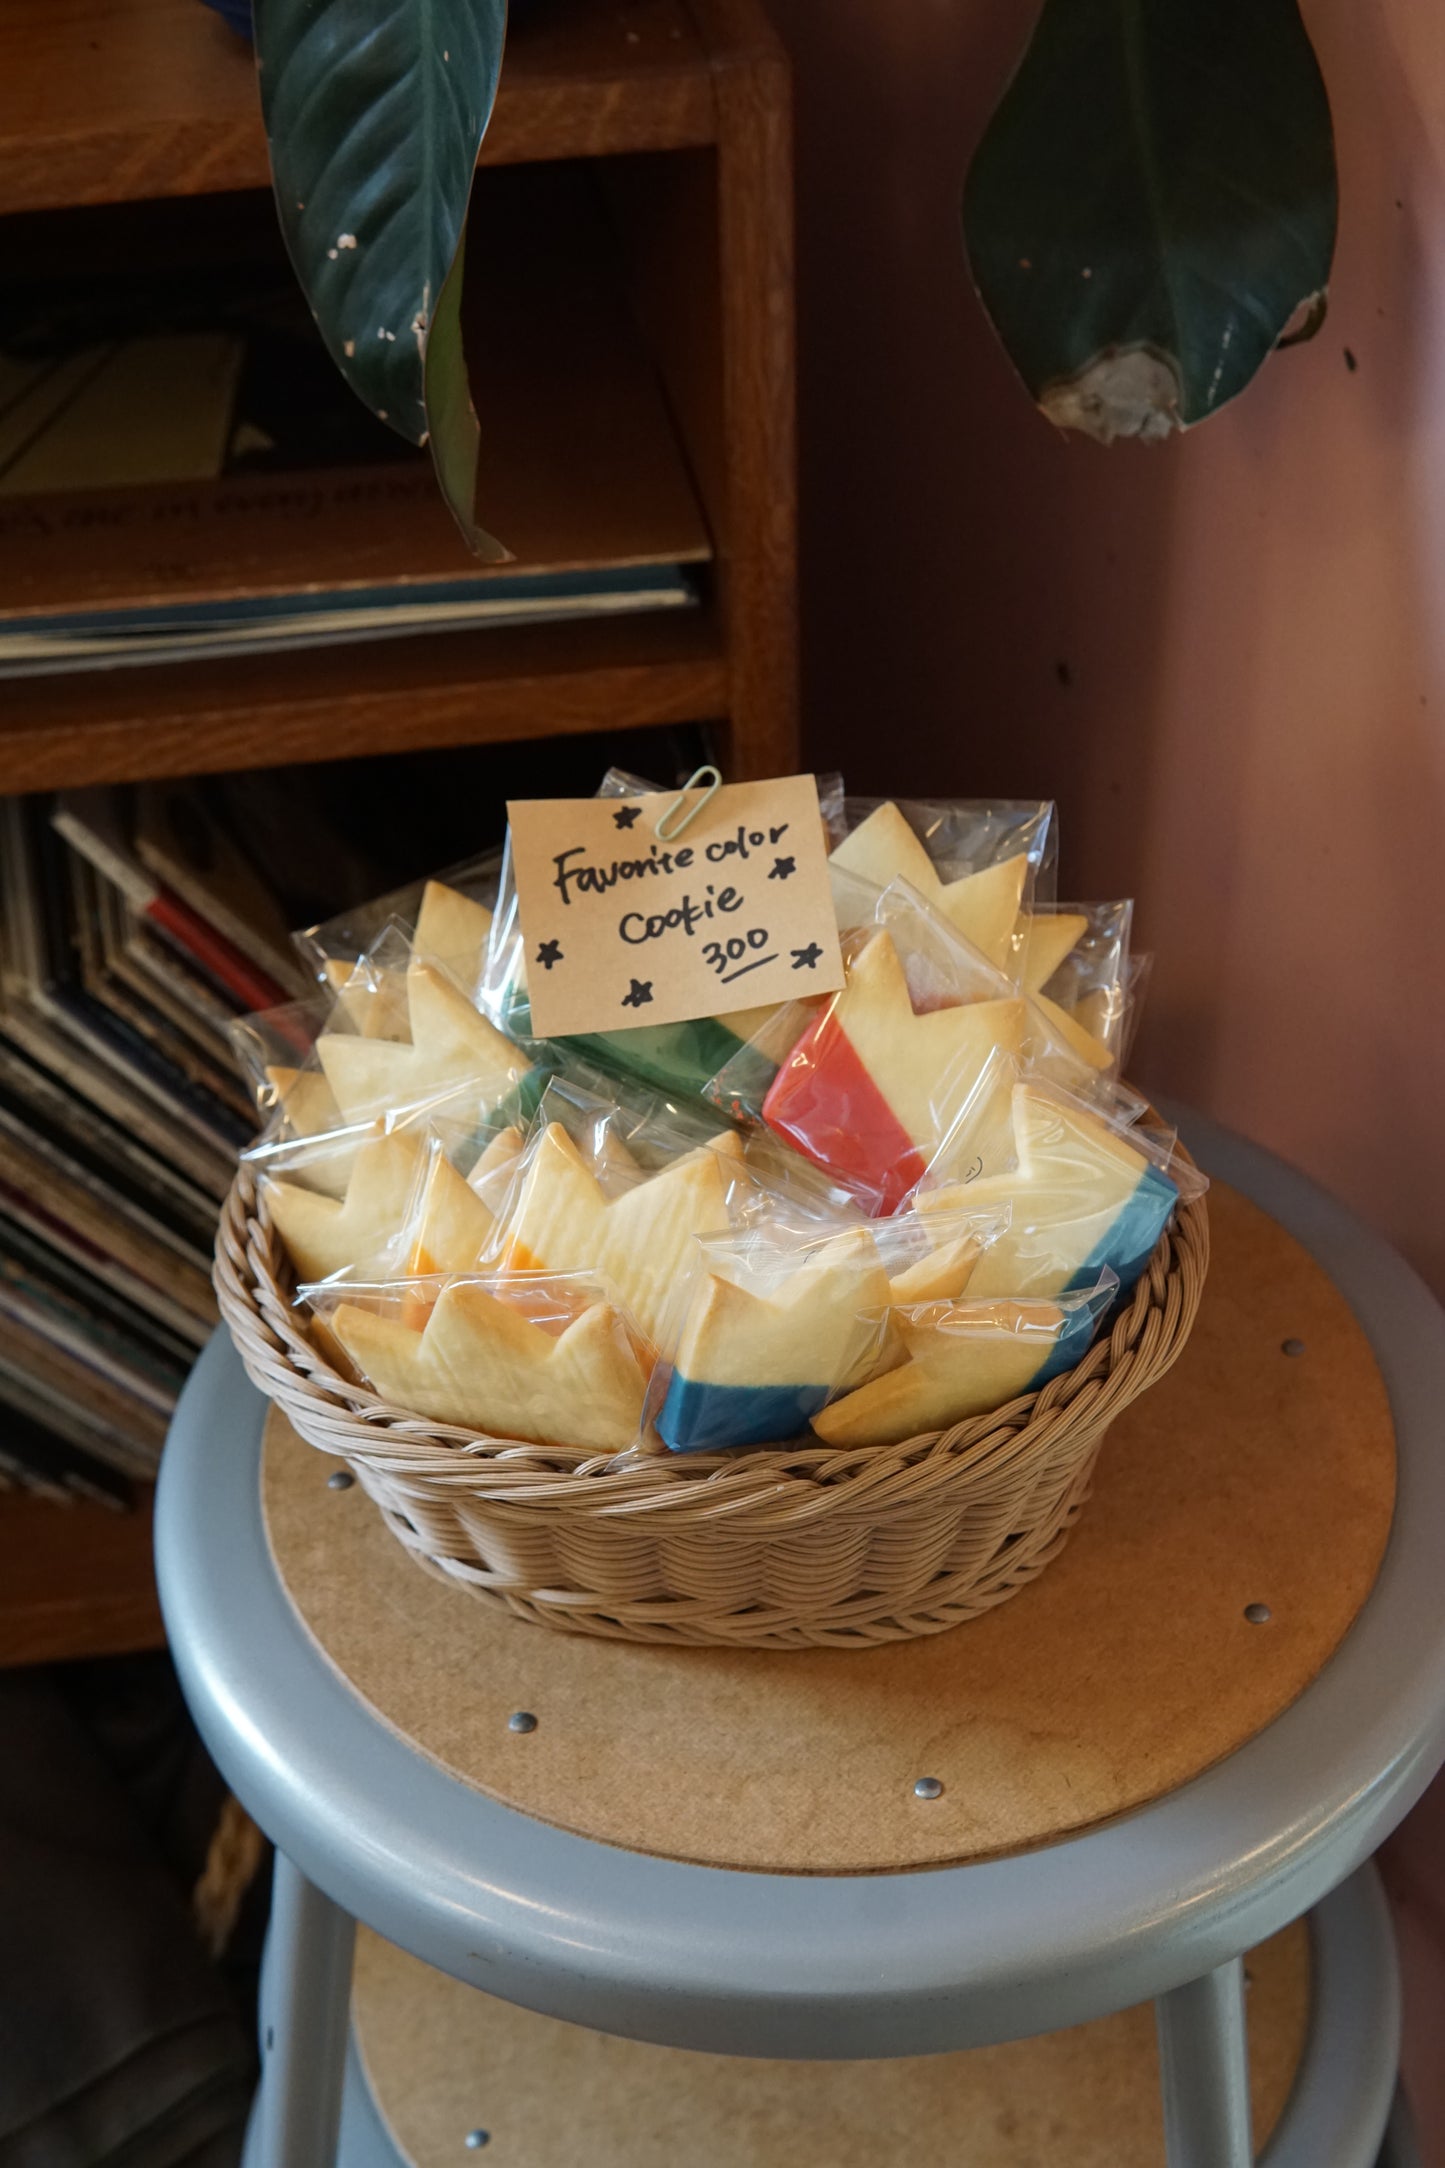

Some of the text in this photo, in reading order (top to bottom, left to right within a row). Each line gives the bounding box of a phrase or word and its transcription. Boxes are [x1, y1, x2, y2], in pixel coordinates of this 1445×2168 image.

[553, 823, 789, 905] Favorite color
[618, 885, 744, 944] Cookie
[701, 928, 769, 974] 300
